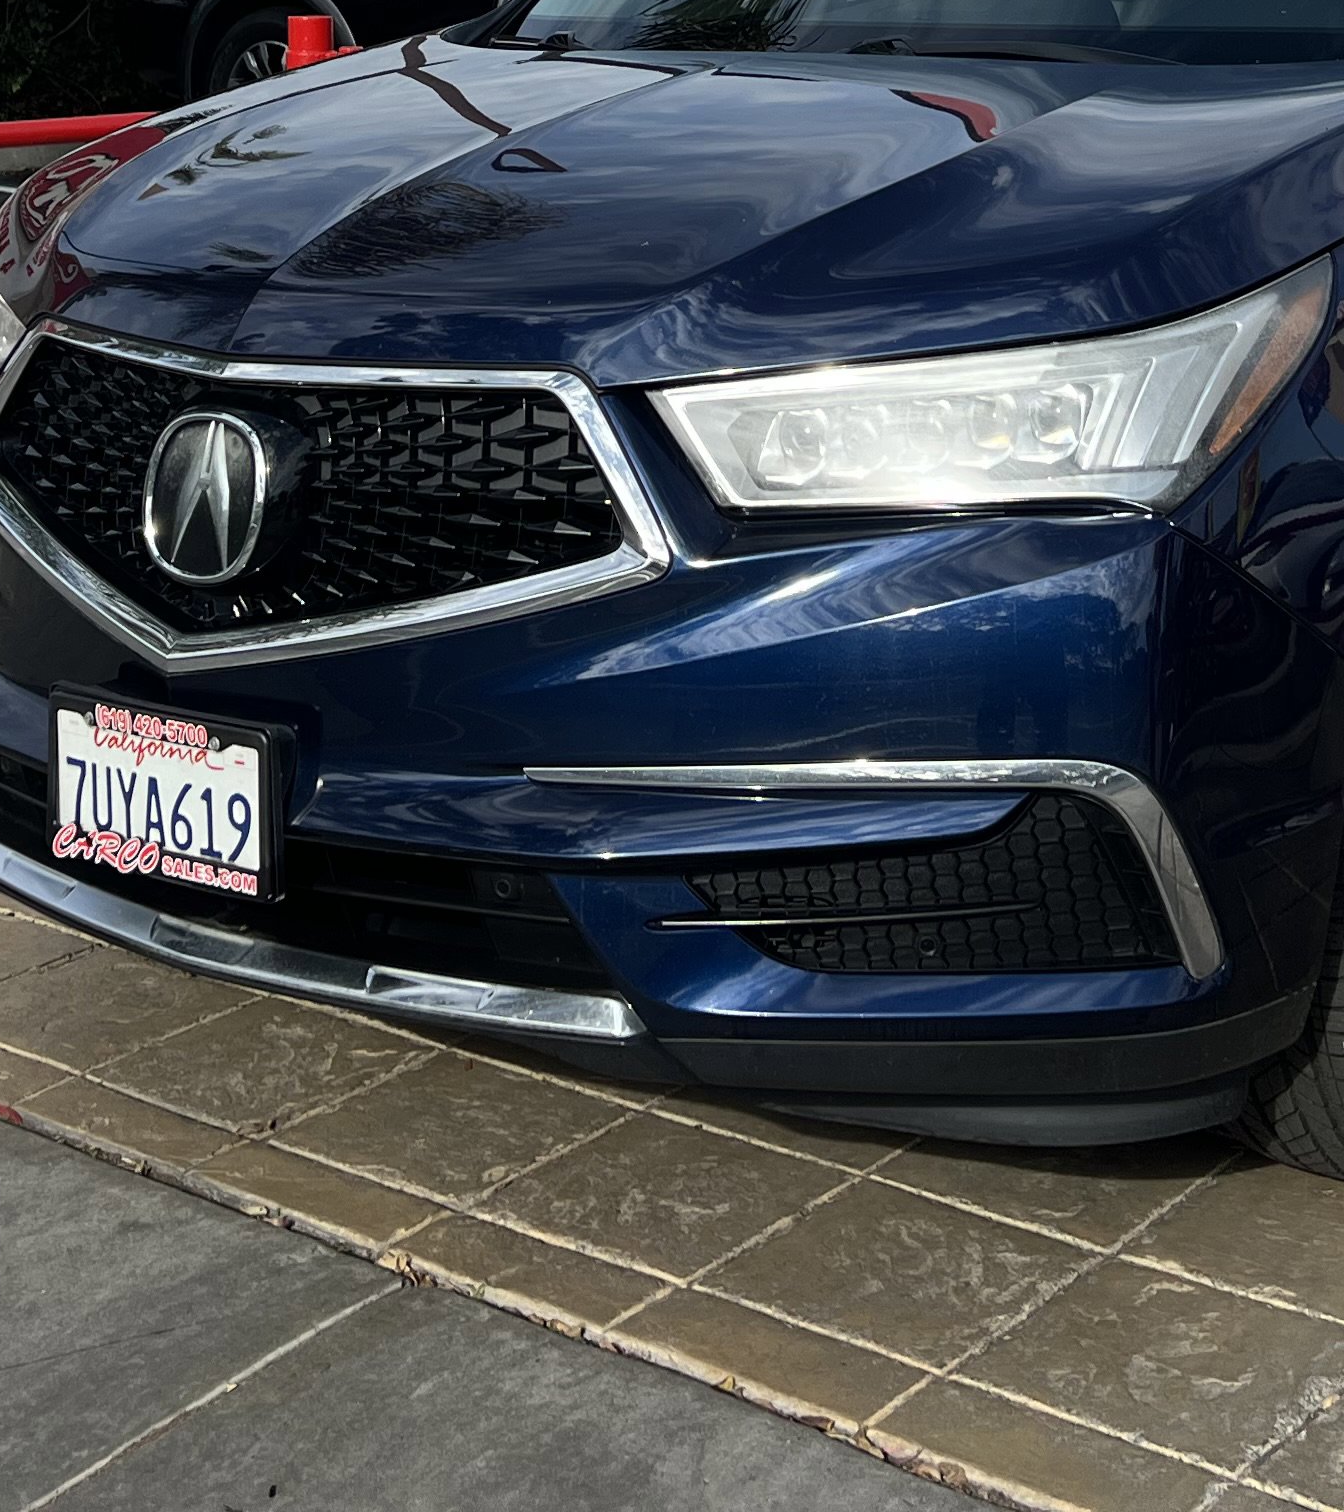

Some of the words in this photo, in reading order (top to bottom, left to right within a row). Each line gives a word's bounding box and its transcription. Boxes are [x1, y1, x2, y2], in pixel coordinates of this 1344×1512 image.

[93, 728, 225, 770] California
[94, 703, 132, 738] (619)
[134, 714, 208, 748] 420-5700
[66, 756, 253, 863] 7UYA619
[52, 823, 160, 874] CARCO
[161, 855, 258, 896] SALES.COM
